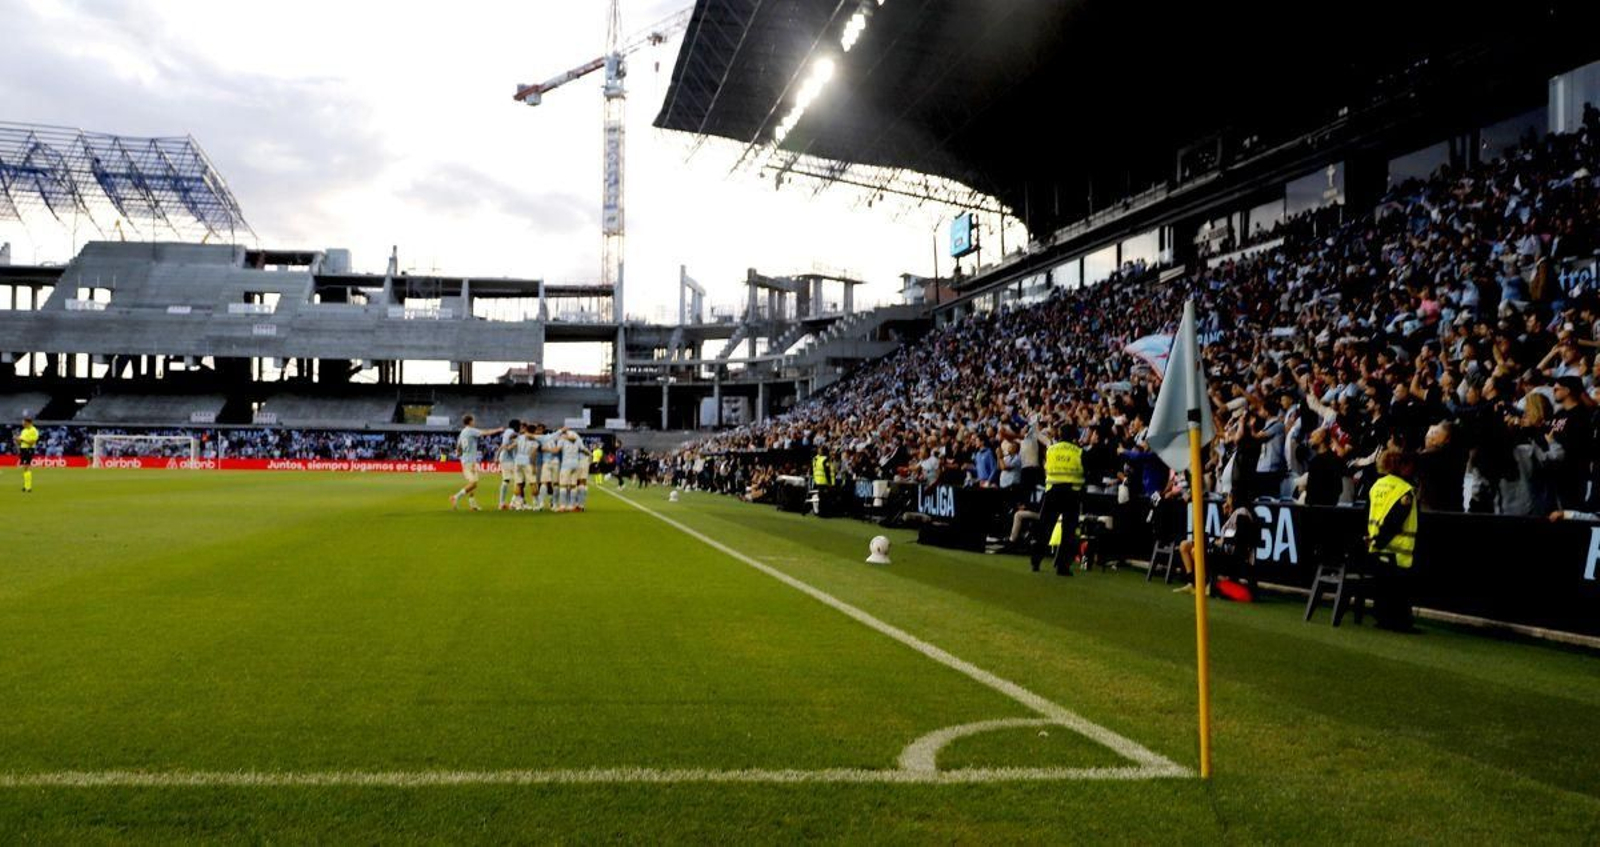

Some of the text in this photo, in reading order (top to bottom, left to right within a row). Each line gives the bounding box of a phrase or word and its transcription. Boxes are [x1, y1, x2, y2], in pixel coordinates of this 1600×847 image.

[30, 456, 67, 467] airbnb
[105, 458, 142, 468] airbnb
[267, 460, 306, 470] Juntos,
[307, 460, 349, 472] siempre
[350, 460, 394, 472] jugamos
[396, 463, 408, 471] en
[475, 460, 502, 472] ALIGA
[918, 484, 955, 518] LALIGA
[1187, 502, 1298, 564] LAGA
